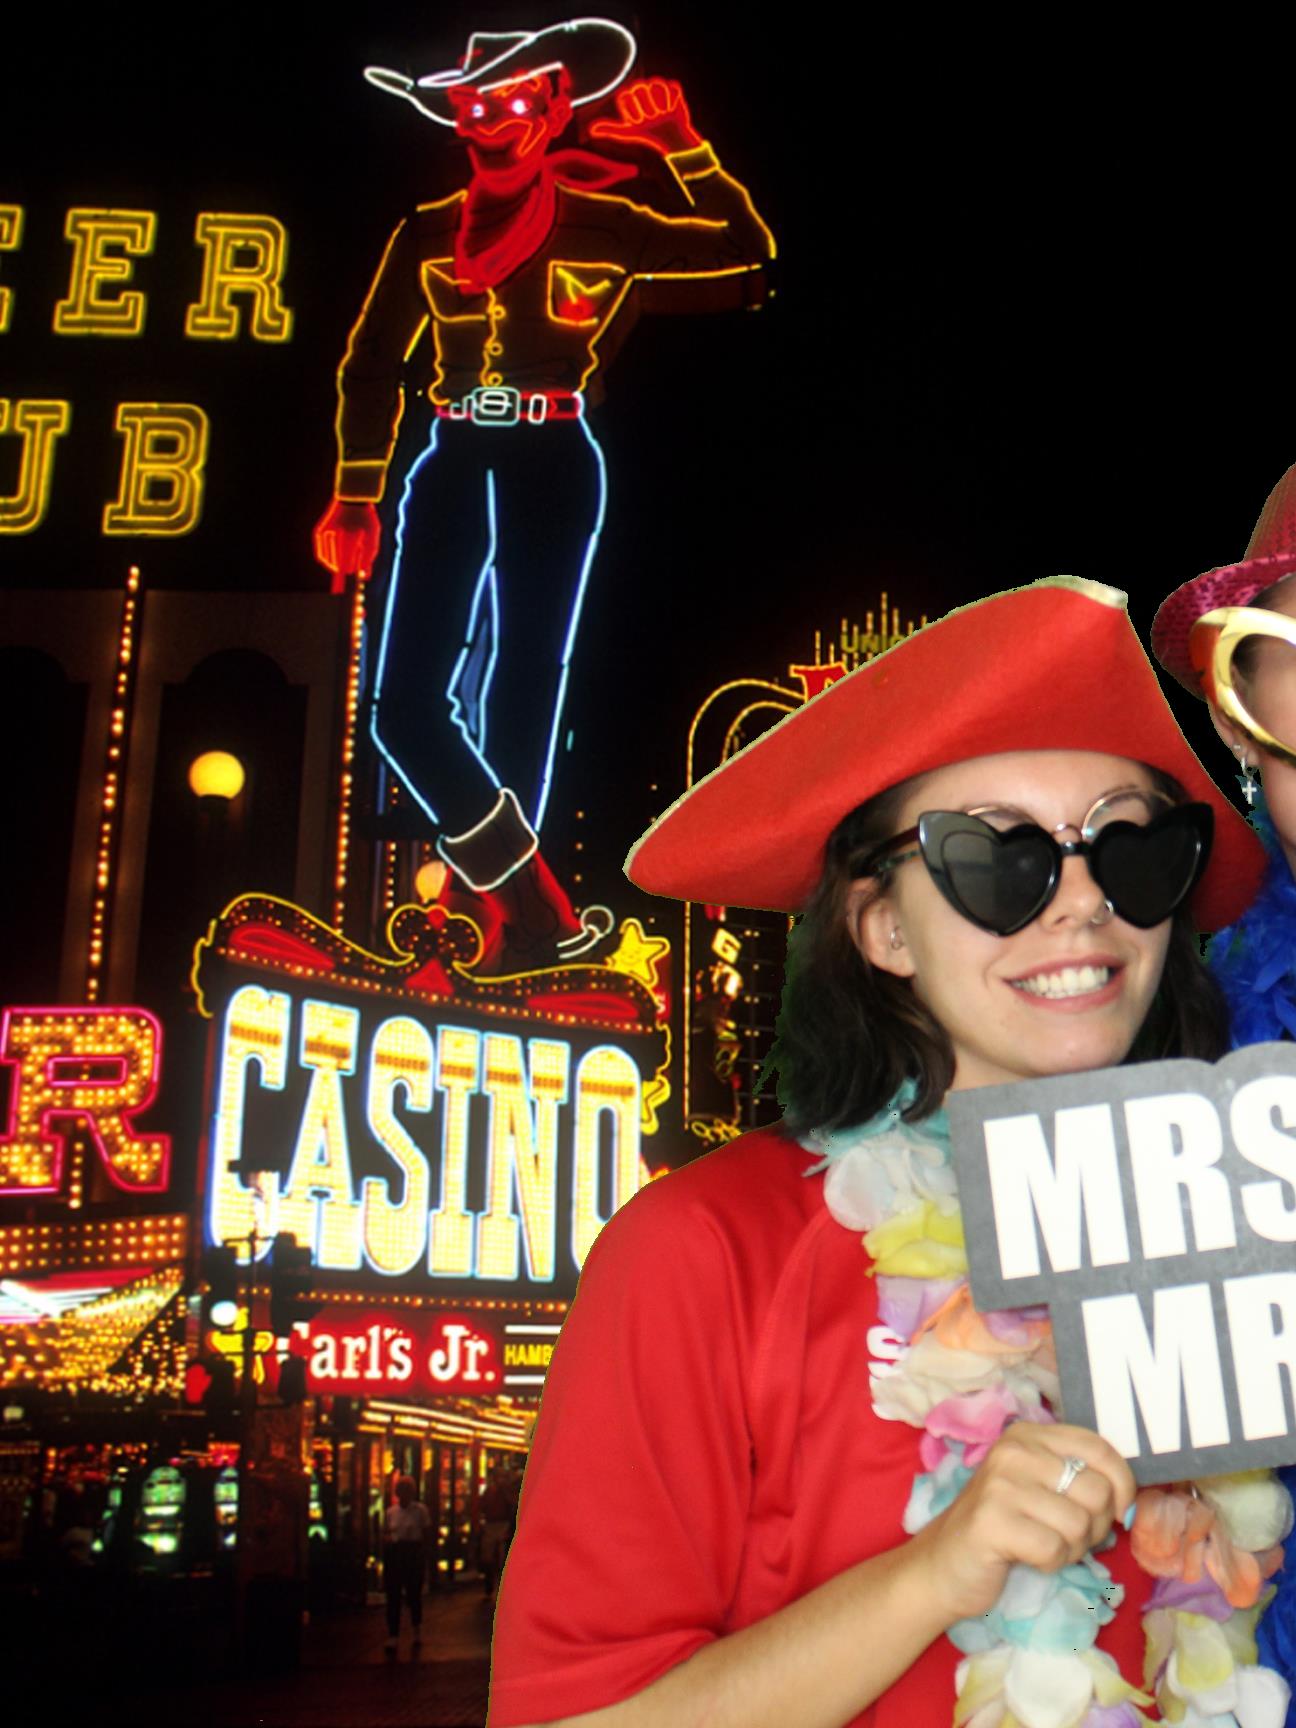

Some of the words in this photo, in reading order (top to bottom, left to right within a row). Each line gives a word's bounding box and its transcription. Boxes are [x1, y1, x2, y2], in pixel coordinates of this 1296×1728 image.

[0, 204, 292, 341] ER
[203, 984, 642, 1282] CASINO
[428, 1322, 497, 1382] Jr.
